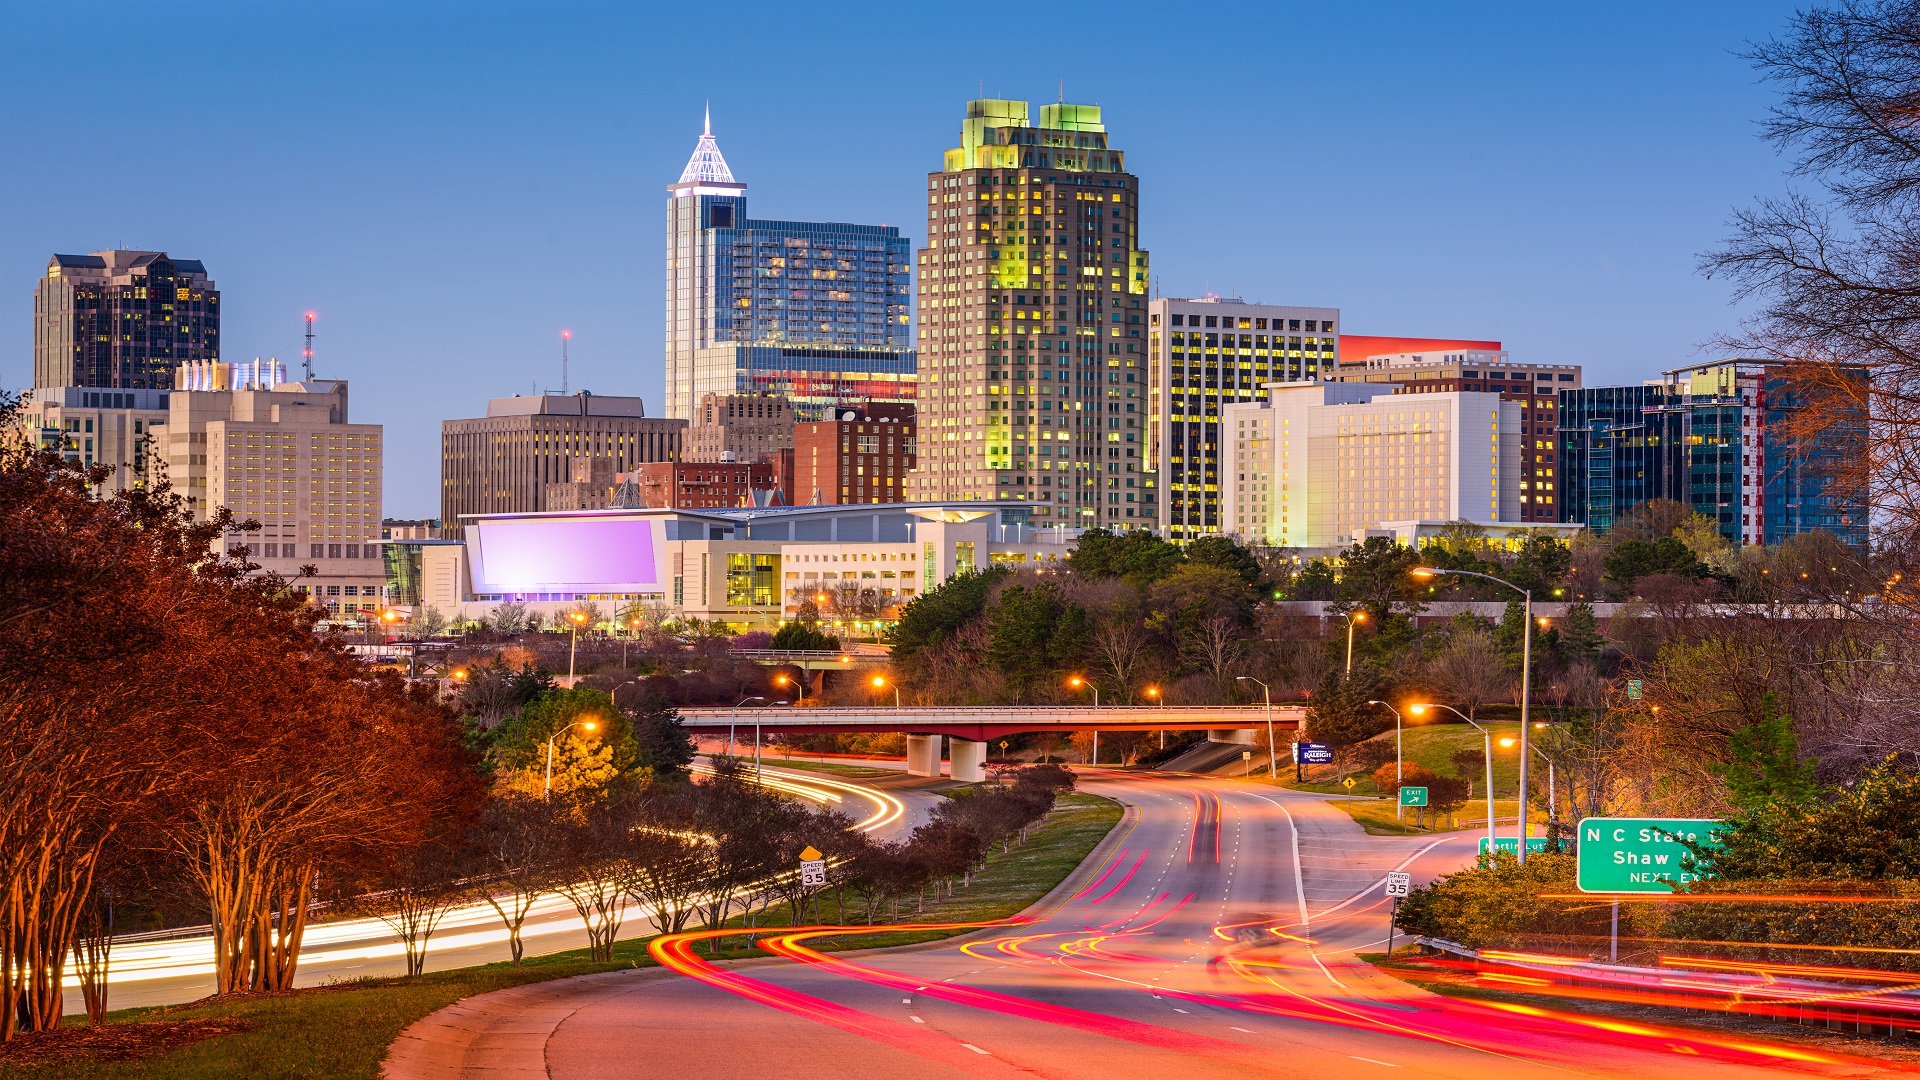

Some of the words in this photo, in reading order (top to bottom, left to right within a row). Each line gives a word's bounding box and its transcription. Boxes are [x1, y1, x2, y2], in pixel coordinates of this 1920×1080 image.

[1587, 828, 1600, 842] N
[1613, 828, 1625, 842] C
[1639, 829, 1697, 843] State
[1613, 851, 1669, 865] Shaw
[805, 873, 824, 883] 35
[1630, 872, 1671, 883] NEXT
[1388, 884, 1407, 894] 35
